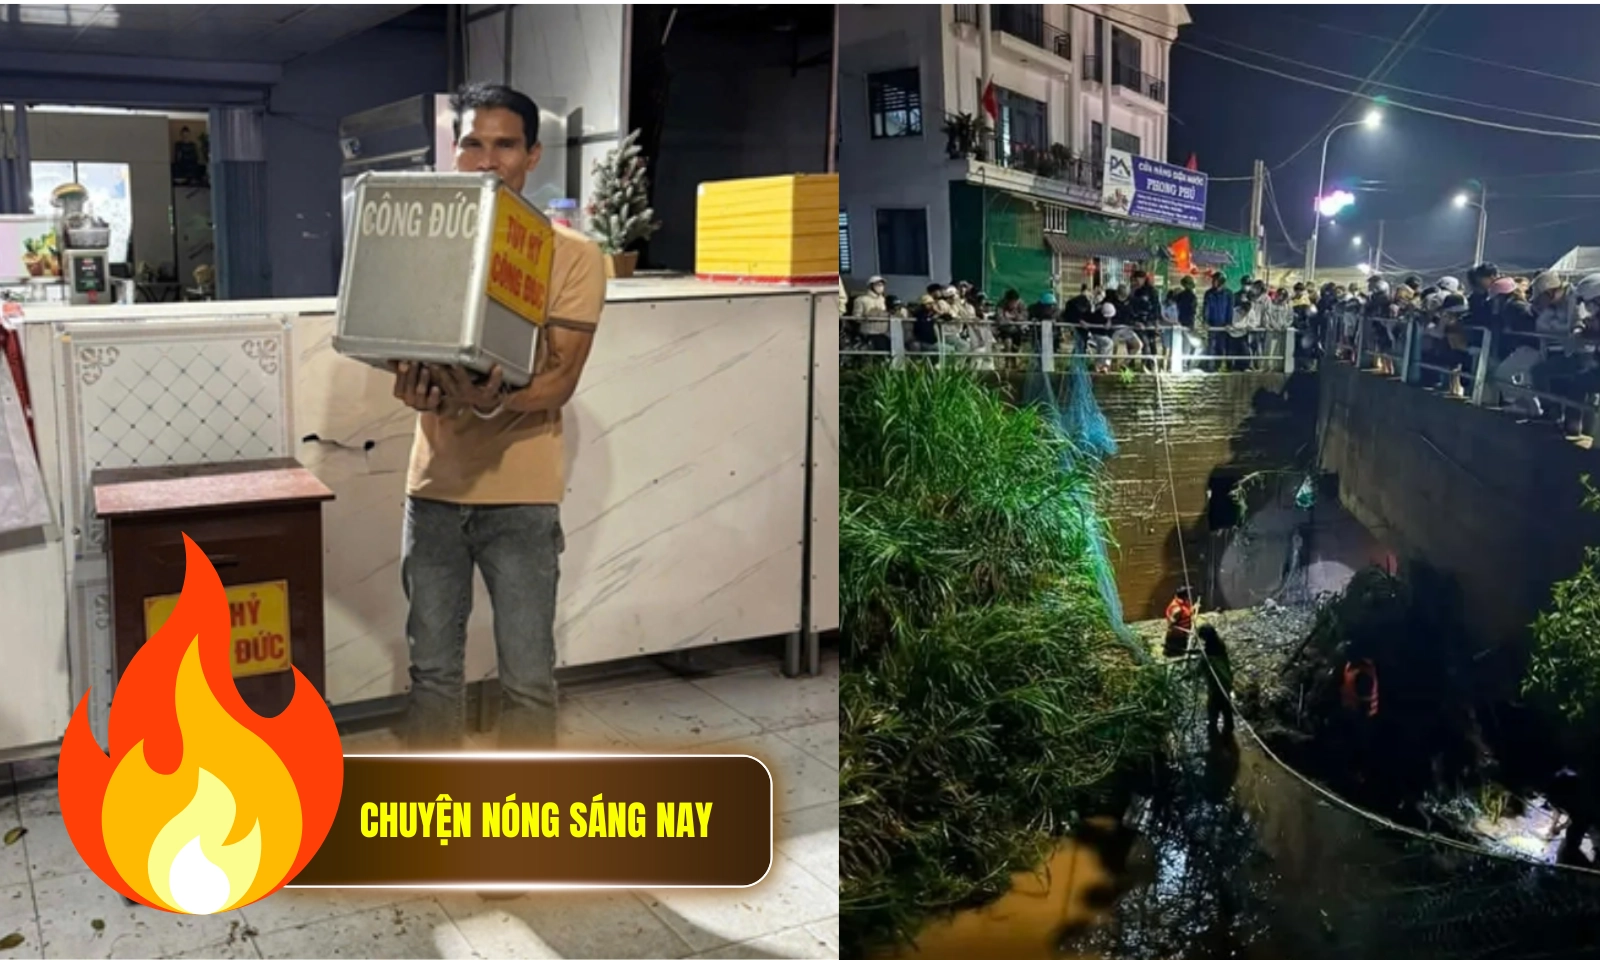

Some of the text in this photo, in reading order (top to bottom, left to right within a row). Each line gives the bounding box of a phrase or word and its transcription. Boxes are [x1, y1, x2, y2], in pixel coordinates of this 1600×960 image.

[1146, 178, 1177, 196] PHONG
[363, 191, 478, 239] CÔNG ĐỨC
[234, 630, 285, 665] ĐỨC
